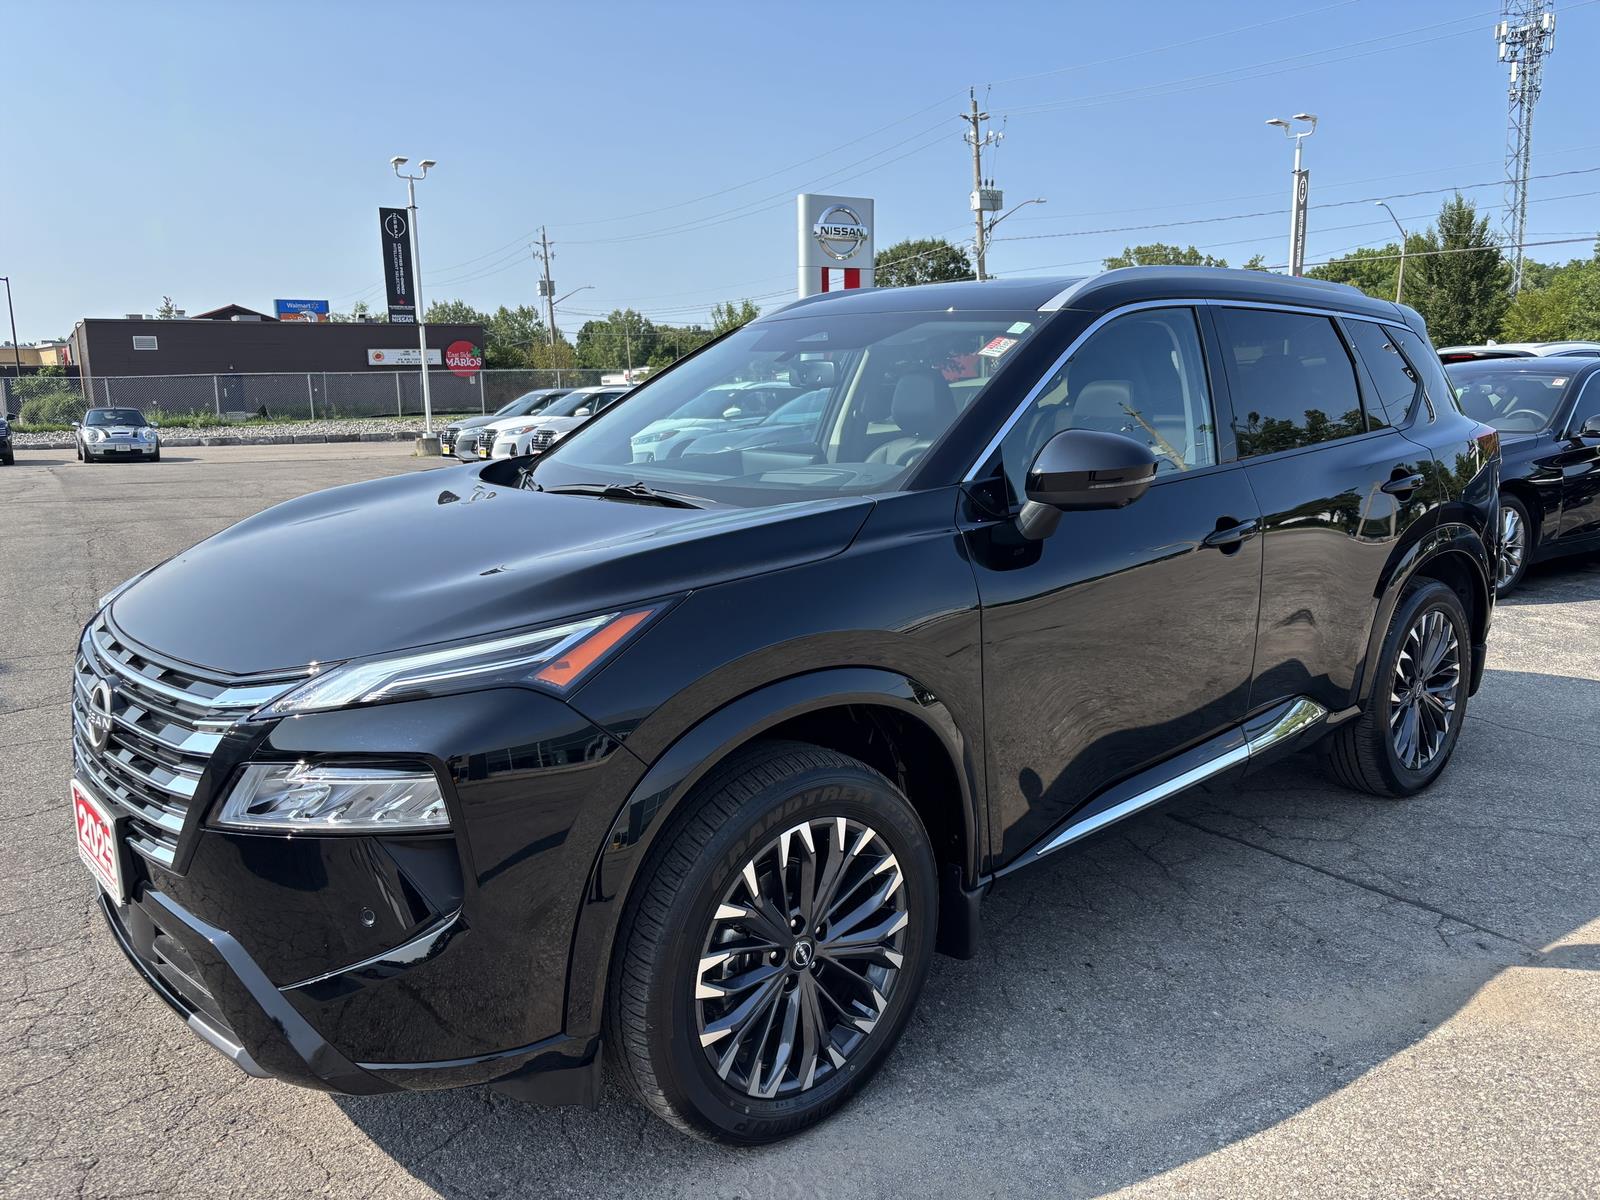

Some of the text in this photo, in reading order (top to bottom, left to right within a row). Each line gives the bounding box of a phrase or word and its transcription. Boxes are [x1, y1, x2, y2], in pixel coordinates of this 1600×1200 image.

[391, 212, 399, 239] NISSAN
[820, 226, 864, 237] NISSAN
[79, 804, 114, 872] 2025
